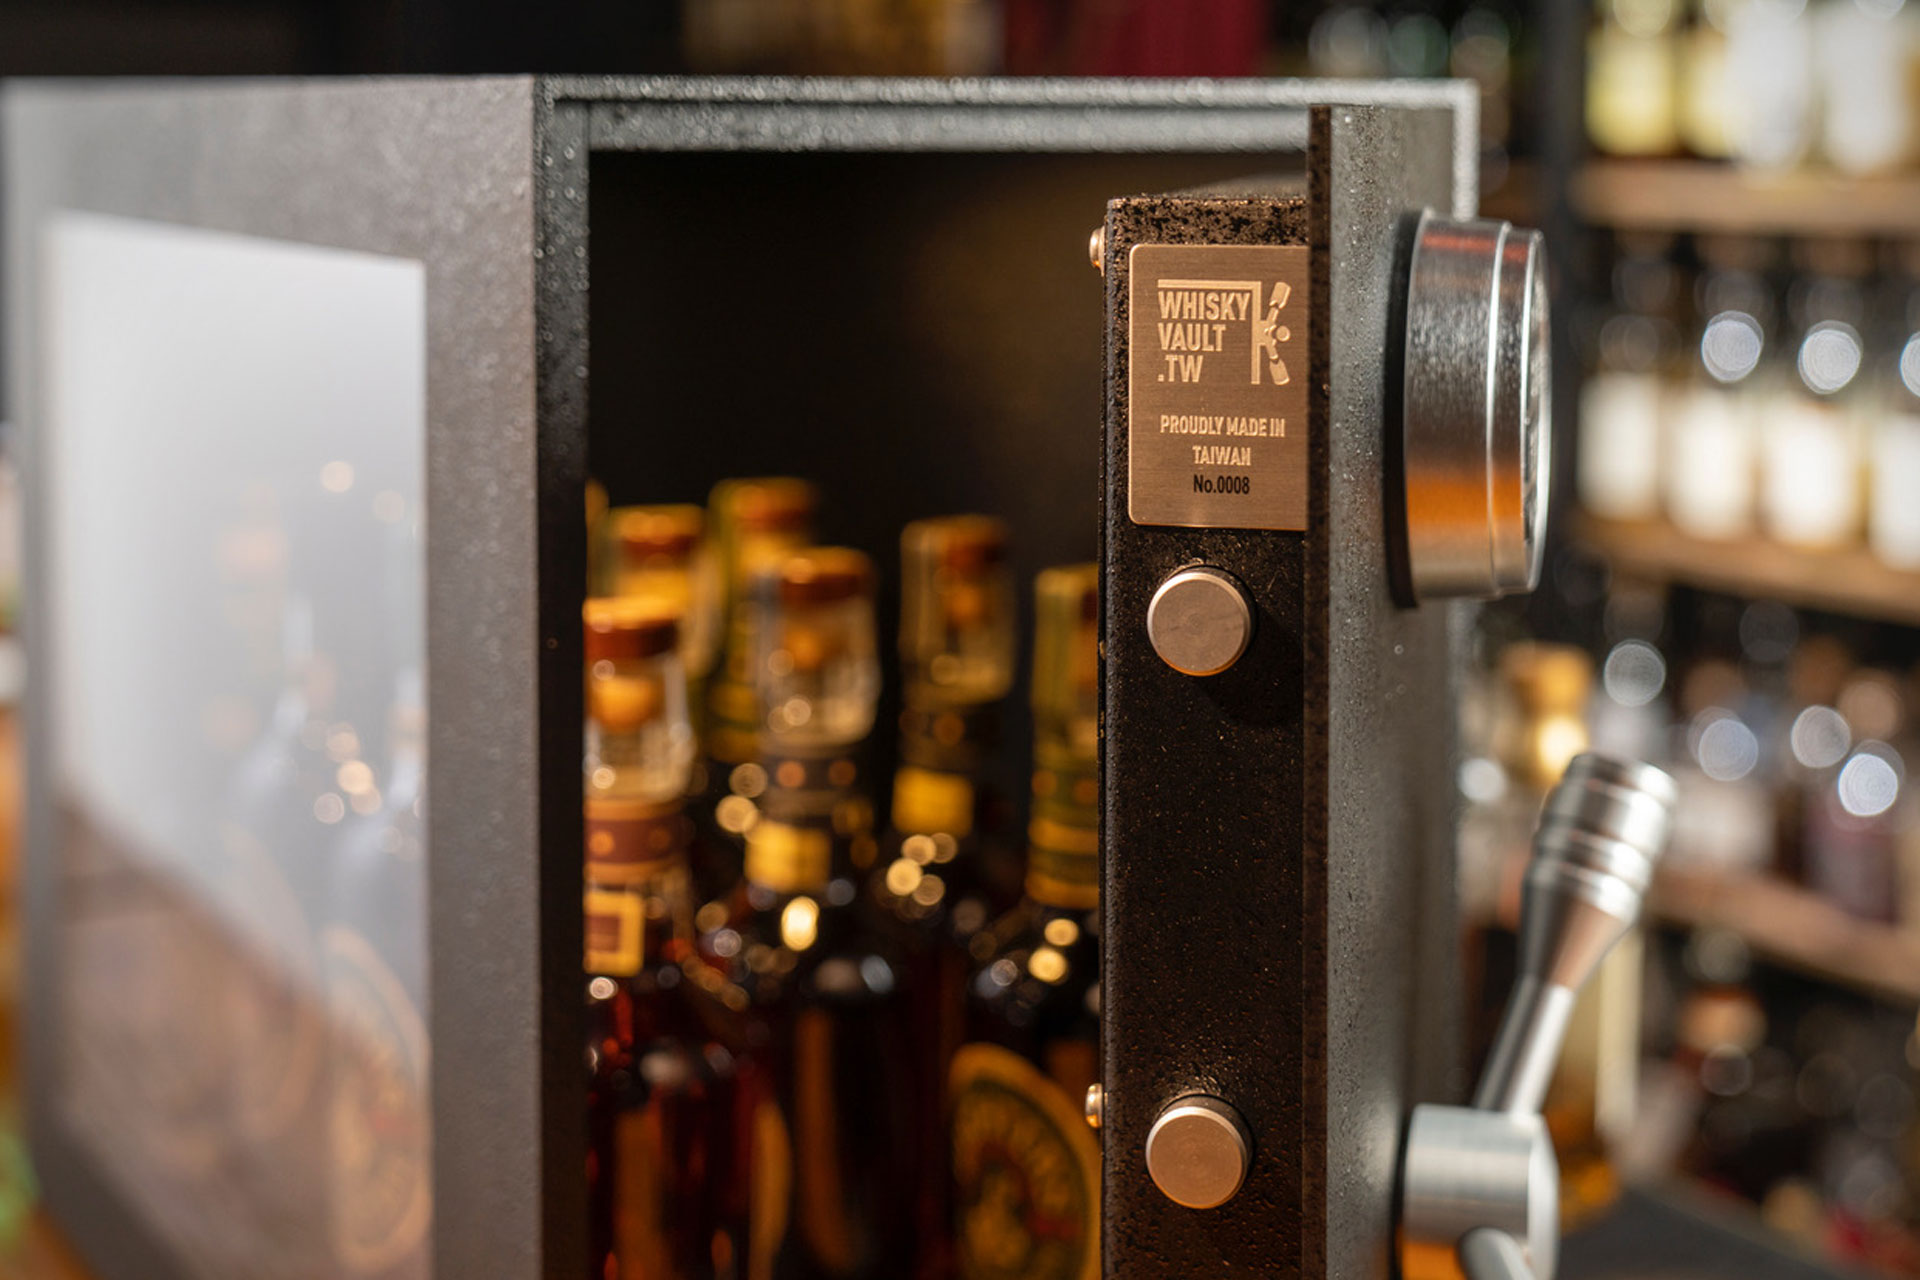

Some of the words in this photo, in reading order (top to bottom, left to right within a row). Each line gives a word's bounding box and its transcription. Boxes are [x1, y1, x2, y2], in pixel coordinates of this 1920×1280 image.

[1157, 291, 1251, 321] WHISKY
[1158, 323, 1227, 352] VAULT
[1157, 355, 1204, 383] .TW
[1159, 415, 1225, 436] PROUDLY
[1226, 417, 1268, 437] MADE
[1269, 419, 1286, 438] IN
[1192, 445, 1252, 467] TAIWAN
[1193, 474, 1251, 494] No.0008
